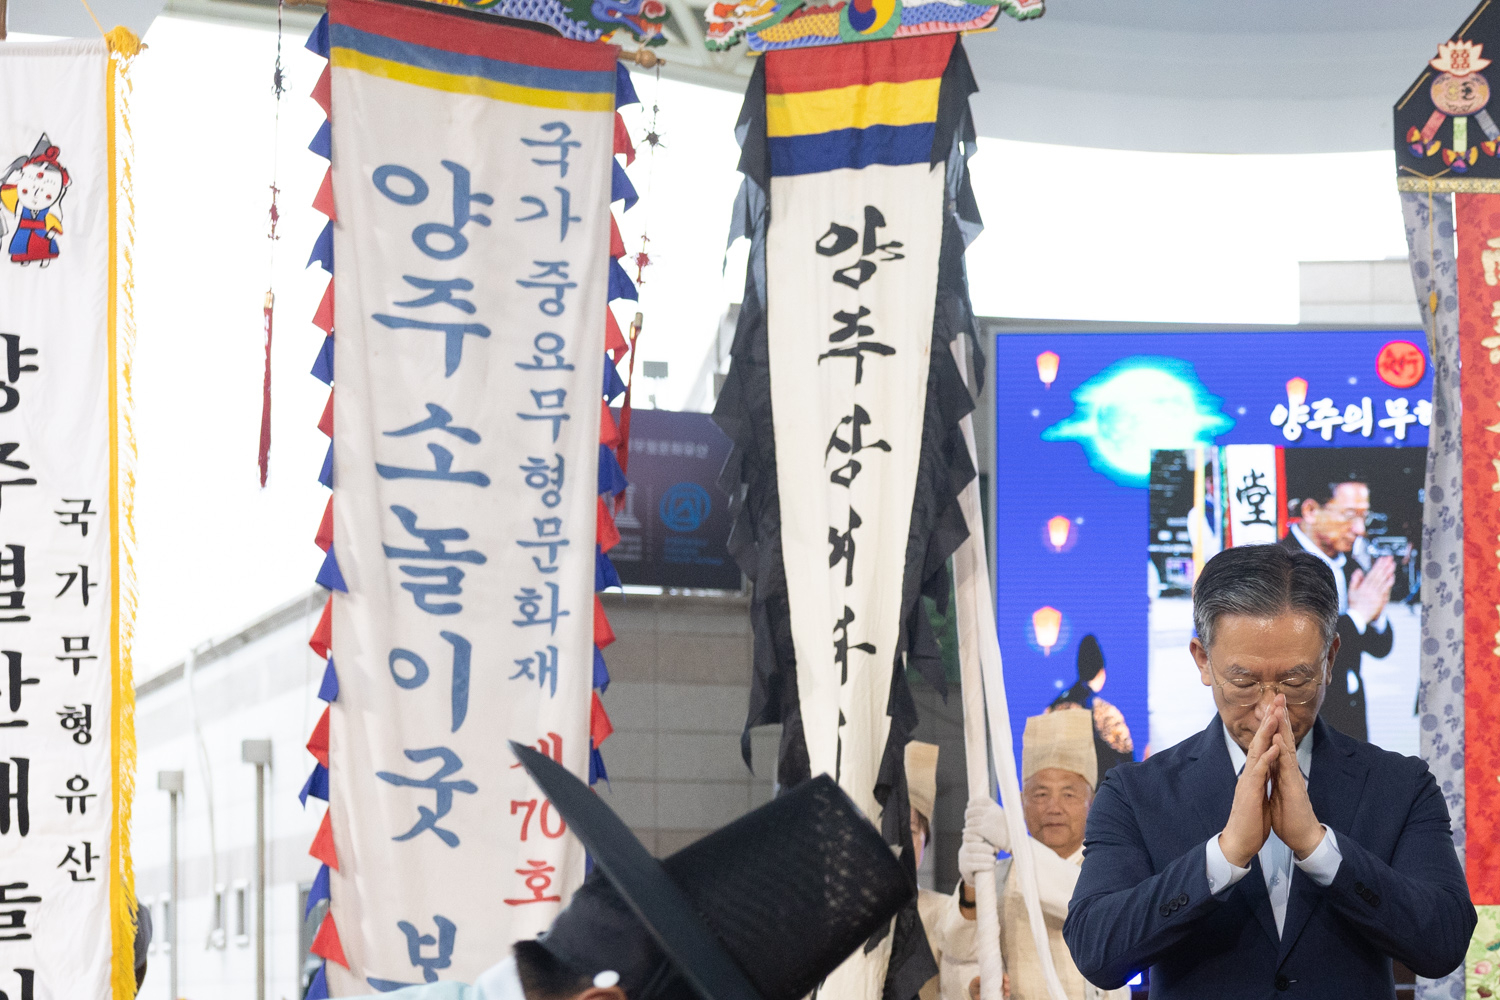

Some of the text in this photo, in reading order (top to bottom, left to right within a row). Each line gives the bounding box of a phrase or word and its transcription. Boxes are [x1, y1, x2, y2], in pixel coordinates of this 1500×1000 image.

[371, 160, 494, 848] 양주소놀이굿
[508, 121, 582, 698] 국가중요무형문화재
[1270, 397, 1373, 441] 양주의
[53, 498, 99, 883] 국가무형유산
